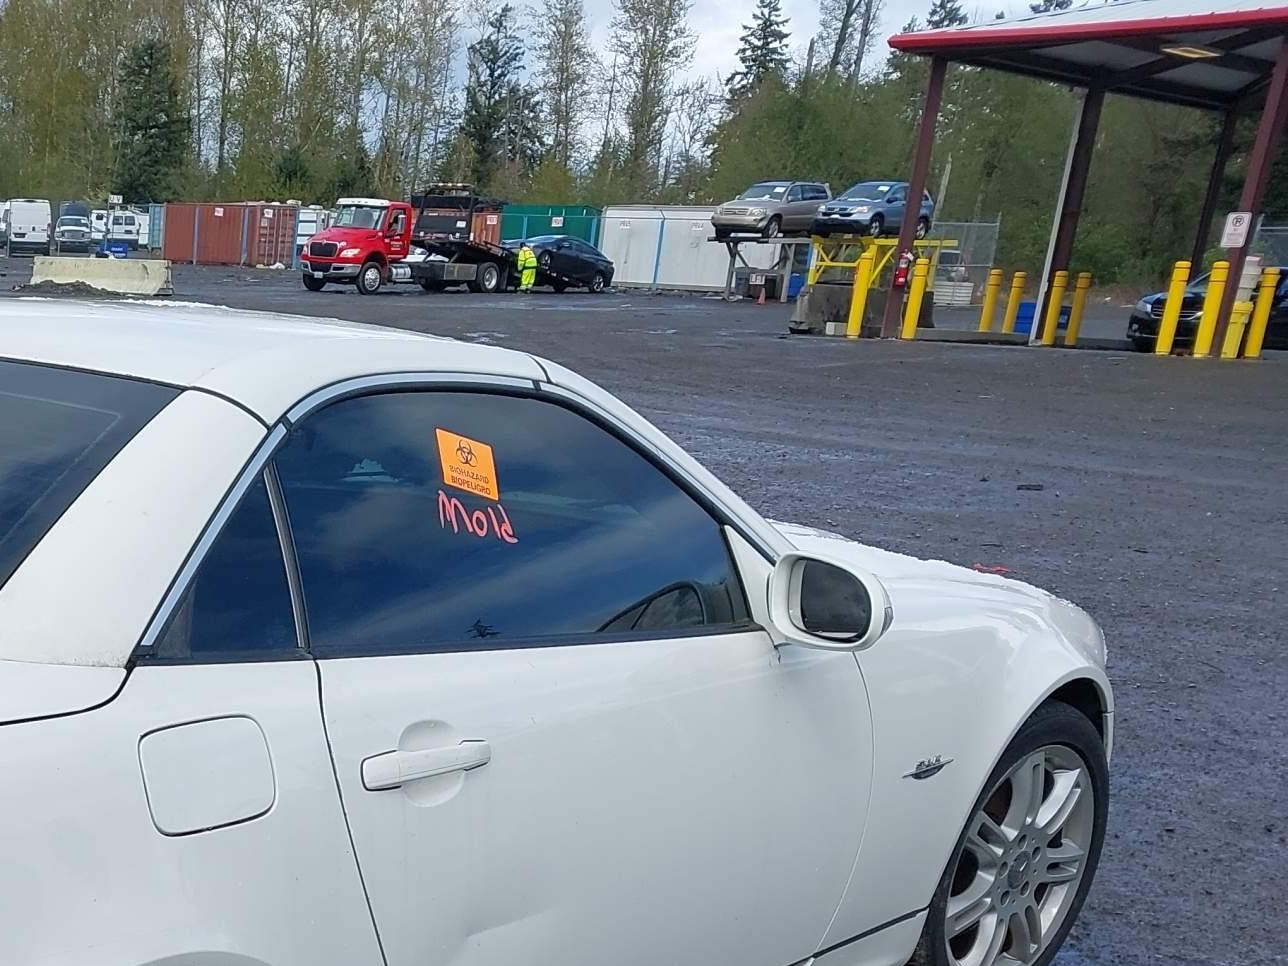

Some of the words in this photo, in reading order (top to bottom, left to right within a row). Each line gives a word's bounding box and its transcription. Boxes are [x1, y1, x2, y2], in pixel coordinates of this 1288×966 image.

[449, 465, 490, 484] BIOHAZARD
[451, 475, 490, 495] BIOPELIGRO
[438, 489, 519, 544] Mold
